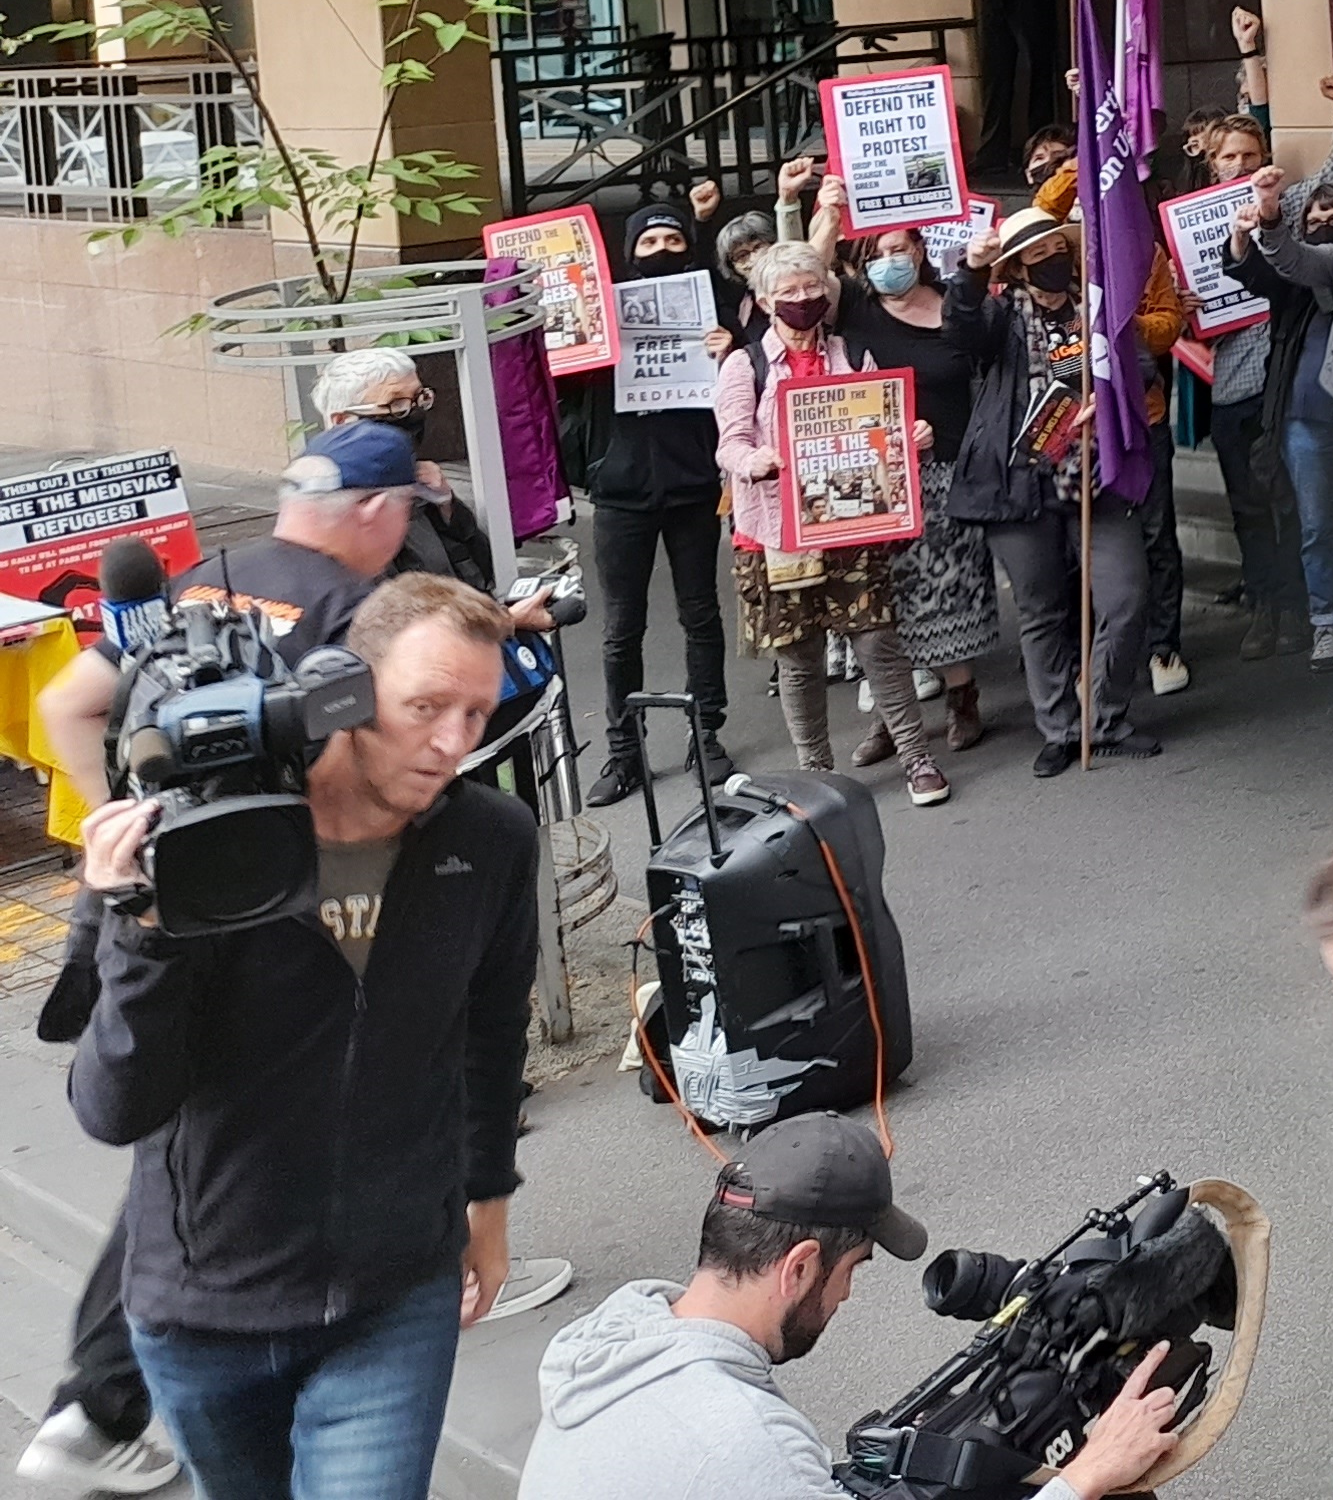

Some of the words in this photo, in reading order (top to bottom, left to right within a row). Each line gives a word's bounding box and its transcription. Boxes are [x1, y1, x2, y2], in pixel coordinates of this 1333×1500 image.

[845, 96, 902, 117] DEFEND
[906, 92, 936, 109] THE
[859, 118, 902, 136] RIGHT
[909, 115, 926, 130] TO
[862, 136, 927, 157] PROTEST
[1178, 204, 1229, 230] DEFEND
[496, 229, 542, 249] DEFEND
[1193, 223, 1230, 245] RIGHT
[542, 268, 568, 286] THE
[635, 339, 682, 352] FREE
[634, 352, 686, 365] THEM
[634, 367, 670, 379] ALL
[793, 388, 845, 406] DEFEND
[850, 390, 867, 400] THE
[794, 406, 832, 422] RIGHT
[838, 407, 848, 415] TO
[795, 418, 853, 436] PROTEST
[796, 437, 835, 457] FREE
[838, 432, 869, 450] THE
[798, 449, 879, 474] REFUGEES
[3, 482, 37, 497] THEM
[77, 468, 98, 482] LET
[100, 463, 134, 477] THEM
[0, 503, 35, 521] REE
[38, 492, 76, 513] THE
[79, 473, 171, 503] MEDEVAC
[32, 504, 138, 539] REFUGEES!
